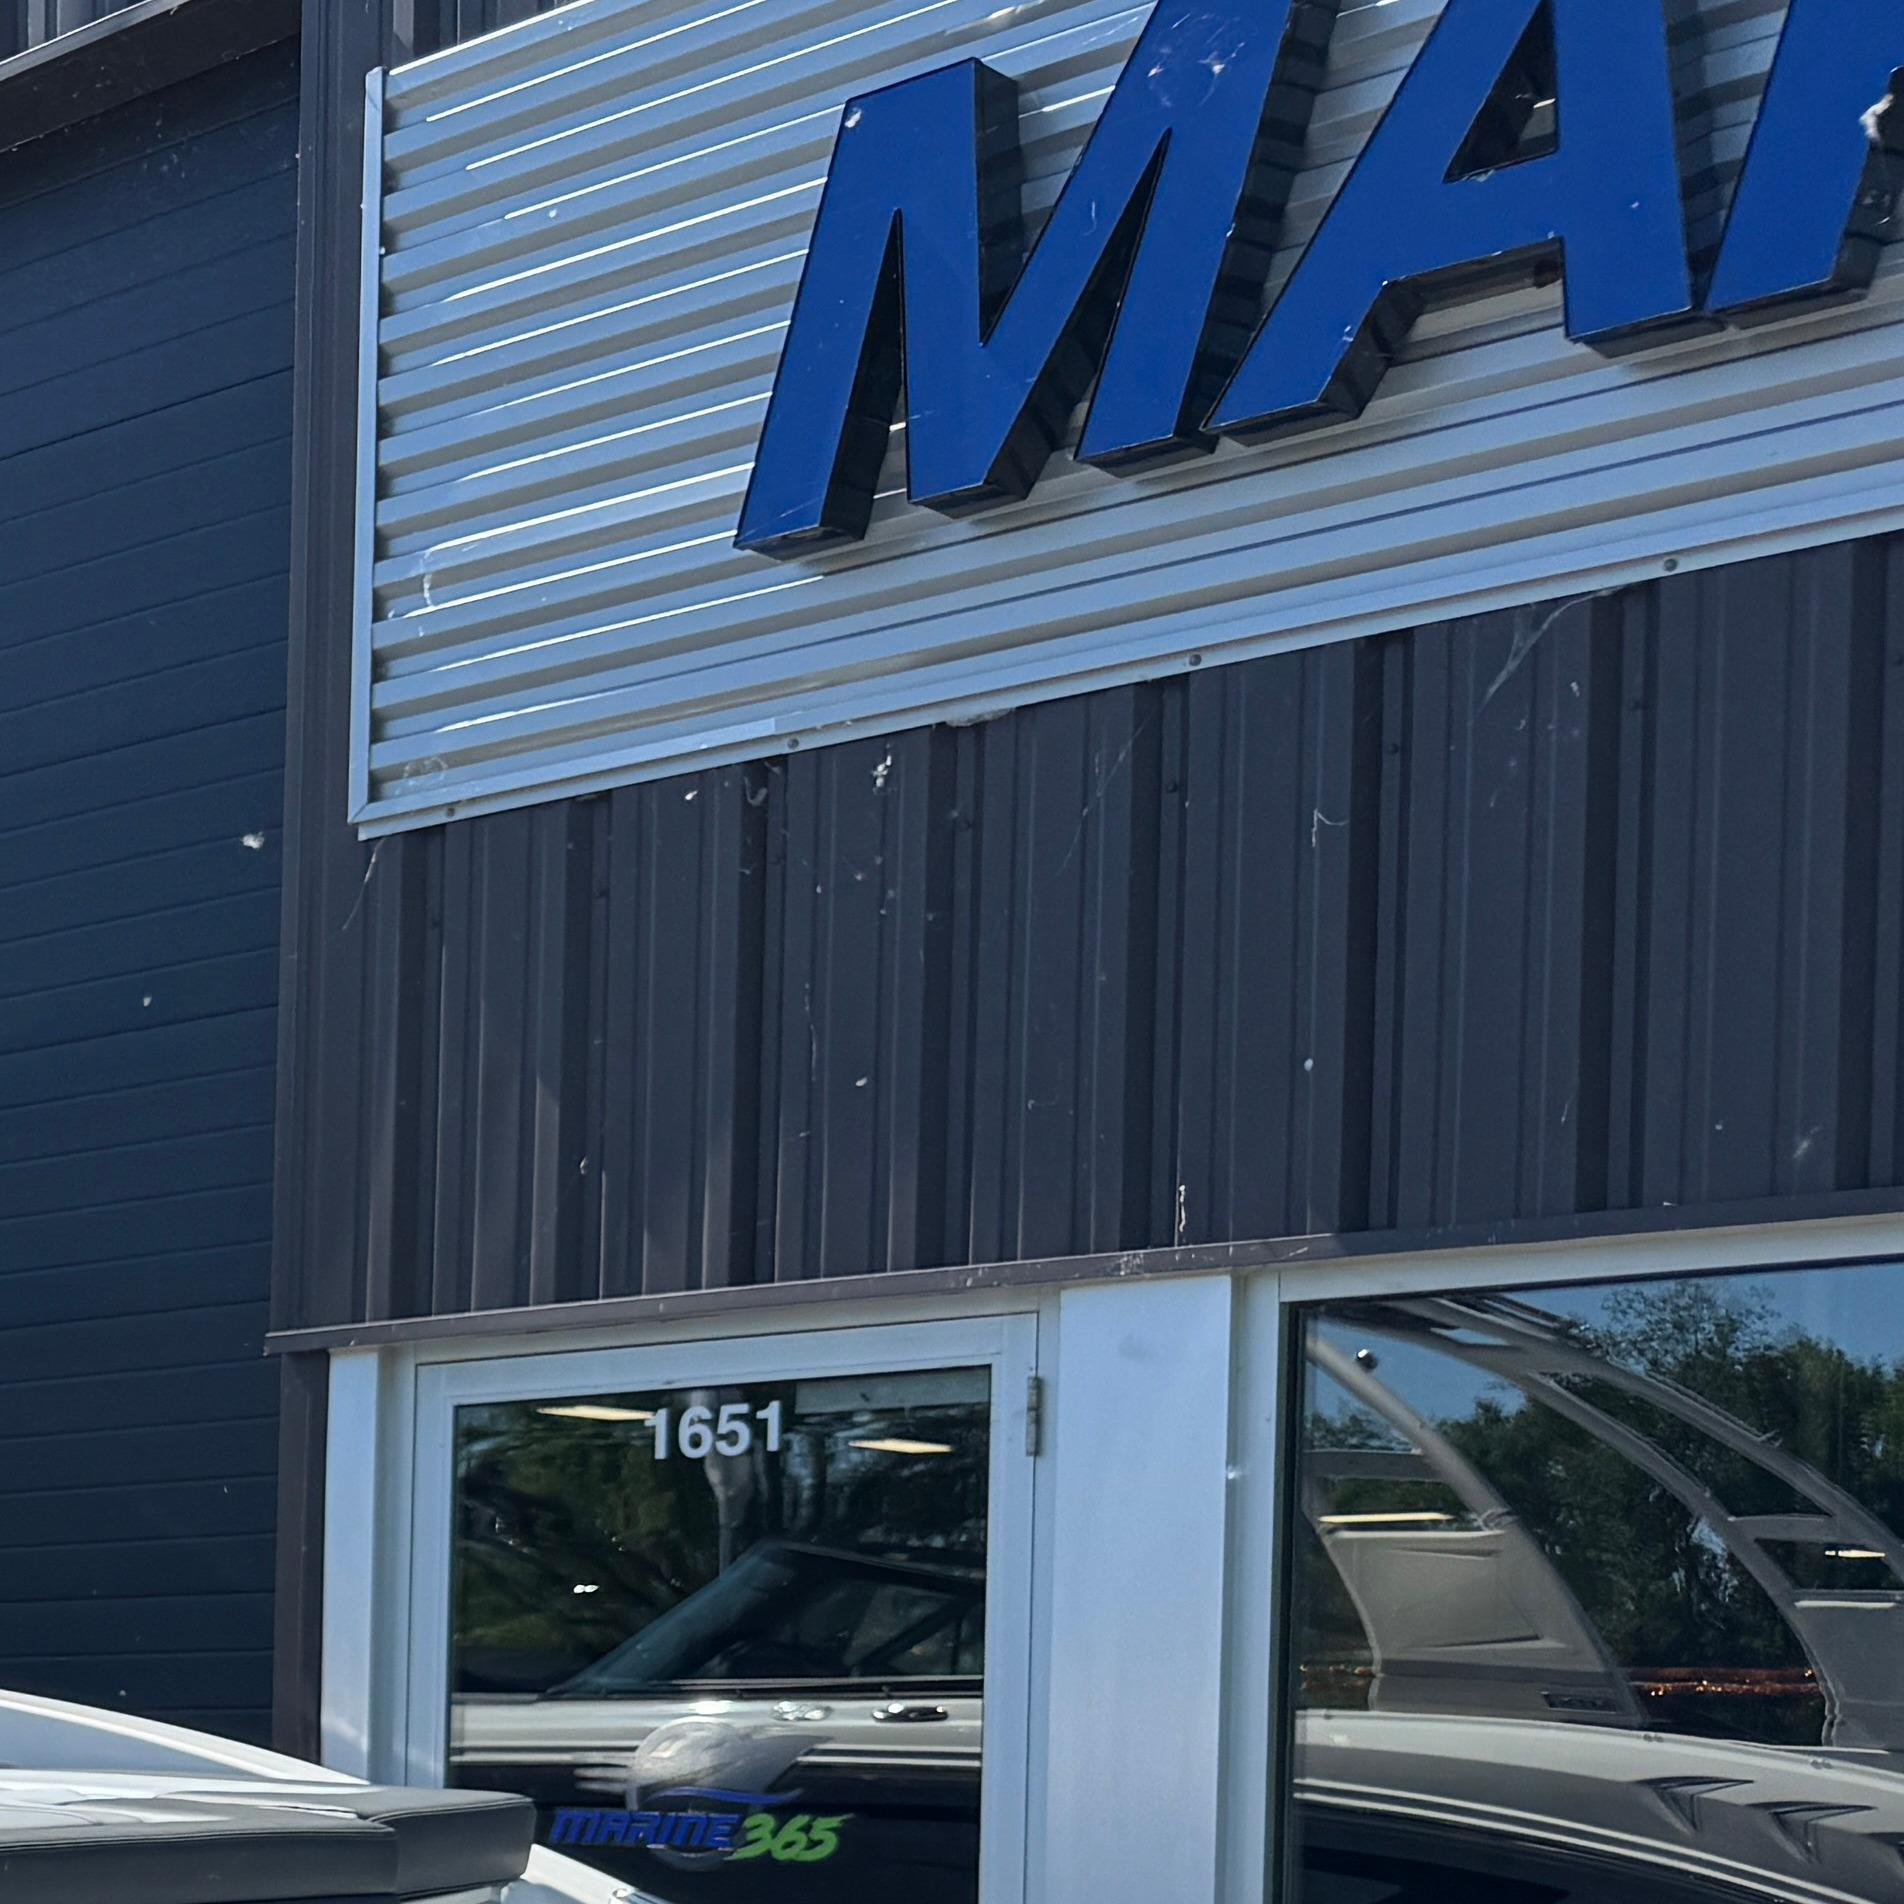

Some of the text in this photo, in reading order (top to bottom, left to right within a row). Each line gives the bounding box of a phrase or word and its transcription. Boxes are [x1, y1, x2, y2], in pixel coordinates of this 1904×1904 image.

[644, 1400, 782, 1460] 1651
[550, 1808, 855, 1861] MARINE 365
